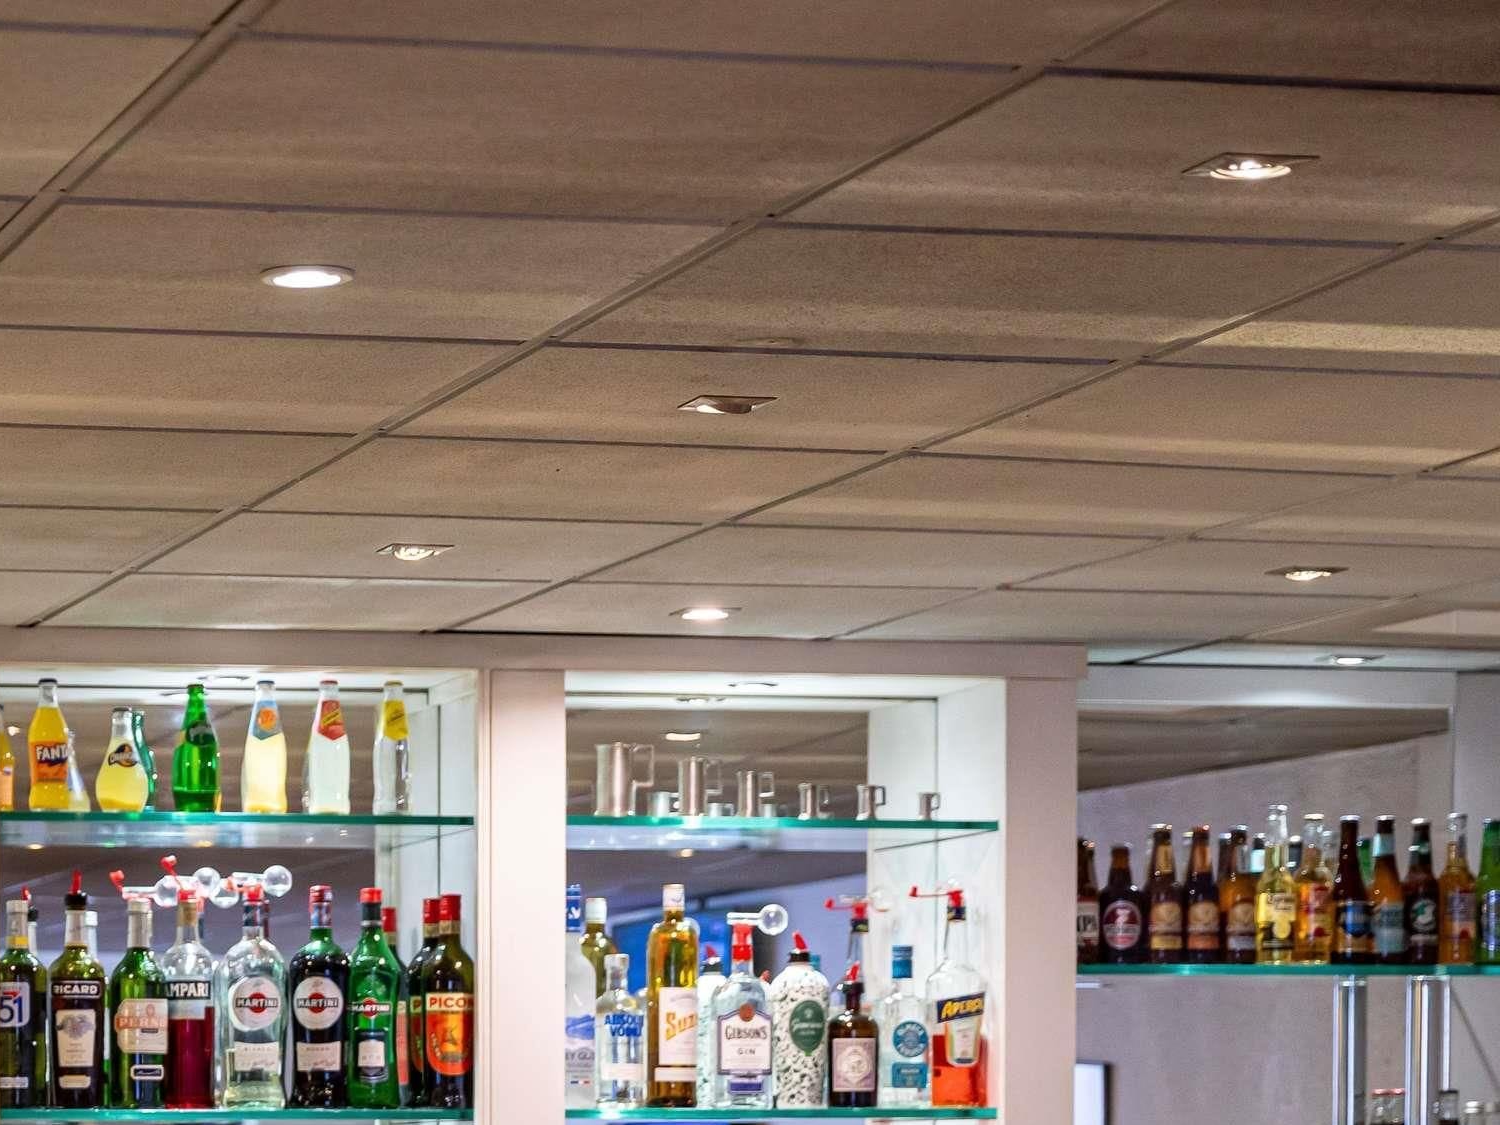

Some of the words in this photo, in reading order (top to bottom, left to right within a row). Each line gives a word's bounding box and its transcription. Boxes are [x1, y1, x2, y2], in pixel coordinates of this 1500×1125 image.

[53, 985, 98, 995] RICARD
[237, 998, 277, 1007] MARTINI
[298, 998, 338, 1007] MARTINI
[429, 996, 469, 1009] PICO
[0, 996, 23, 1023] 51
[351, 1004, 390, 1012] MARTINI
